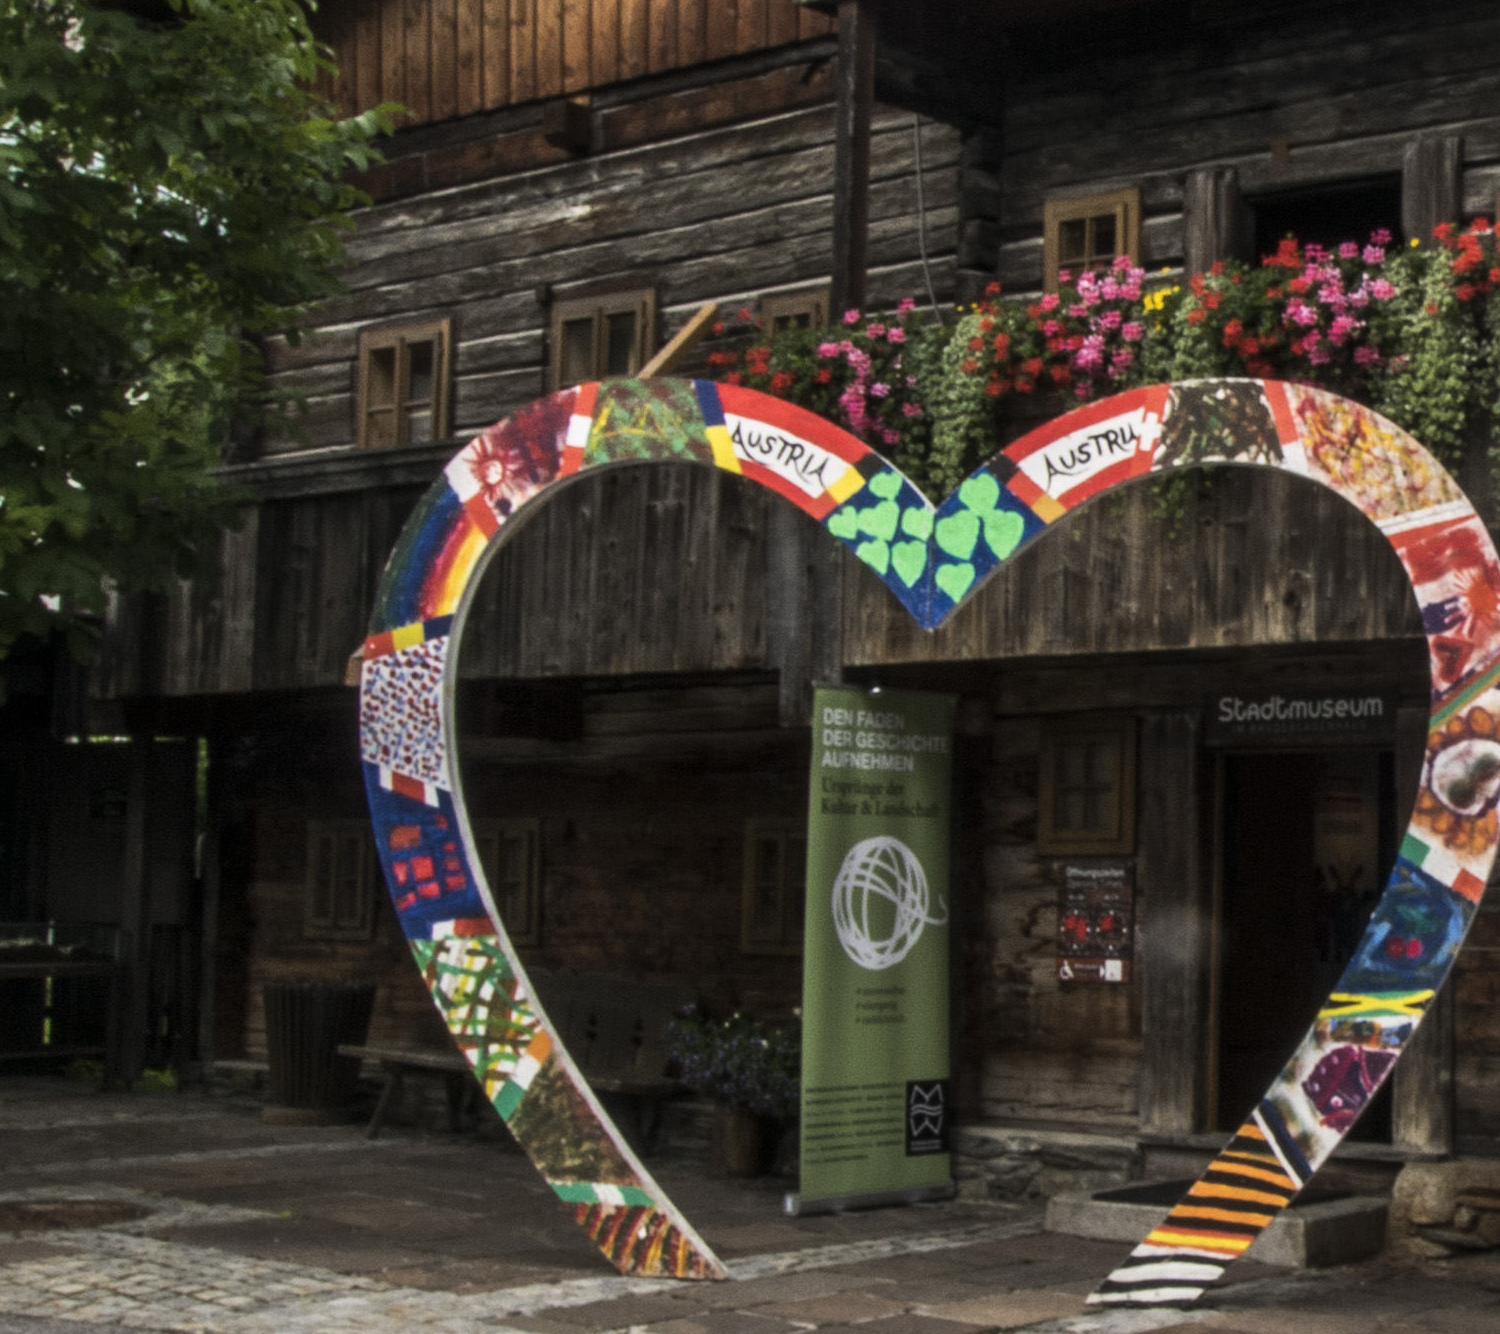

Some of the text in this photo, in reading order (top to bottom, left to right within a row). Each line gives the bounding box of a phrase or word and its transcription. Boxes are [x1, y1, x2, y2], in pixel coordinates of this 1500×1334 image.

[731, 420, 829, 488] AUSTRIA
[823, 708, 905, 730] DEN FADEN
[1218, 695, 1384, 722] Stadtmuseum
[822, 729, 949, 754] DER GESCHICHTE
[821, 750, 914, 772] AUFNEHMEN
